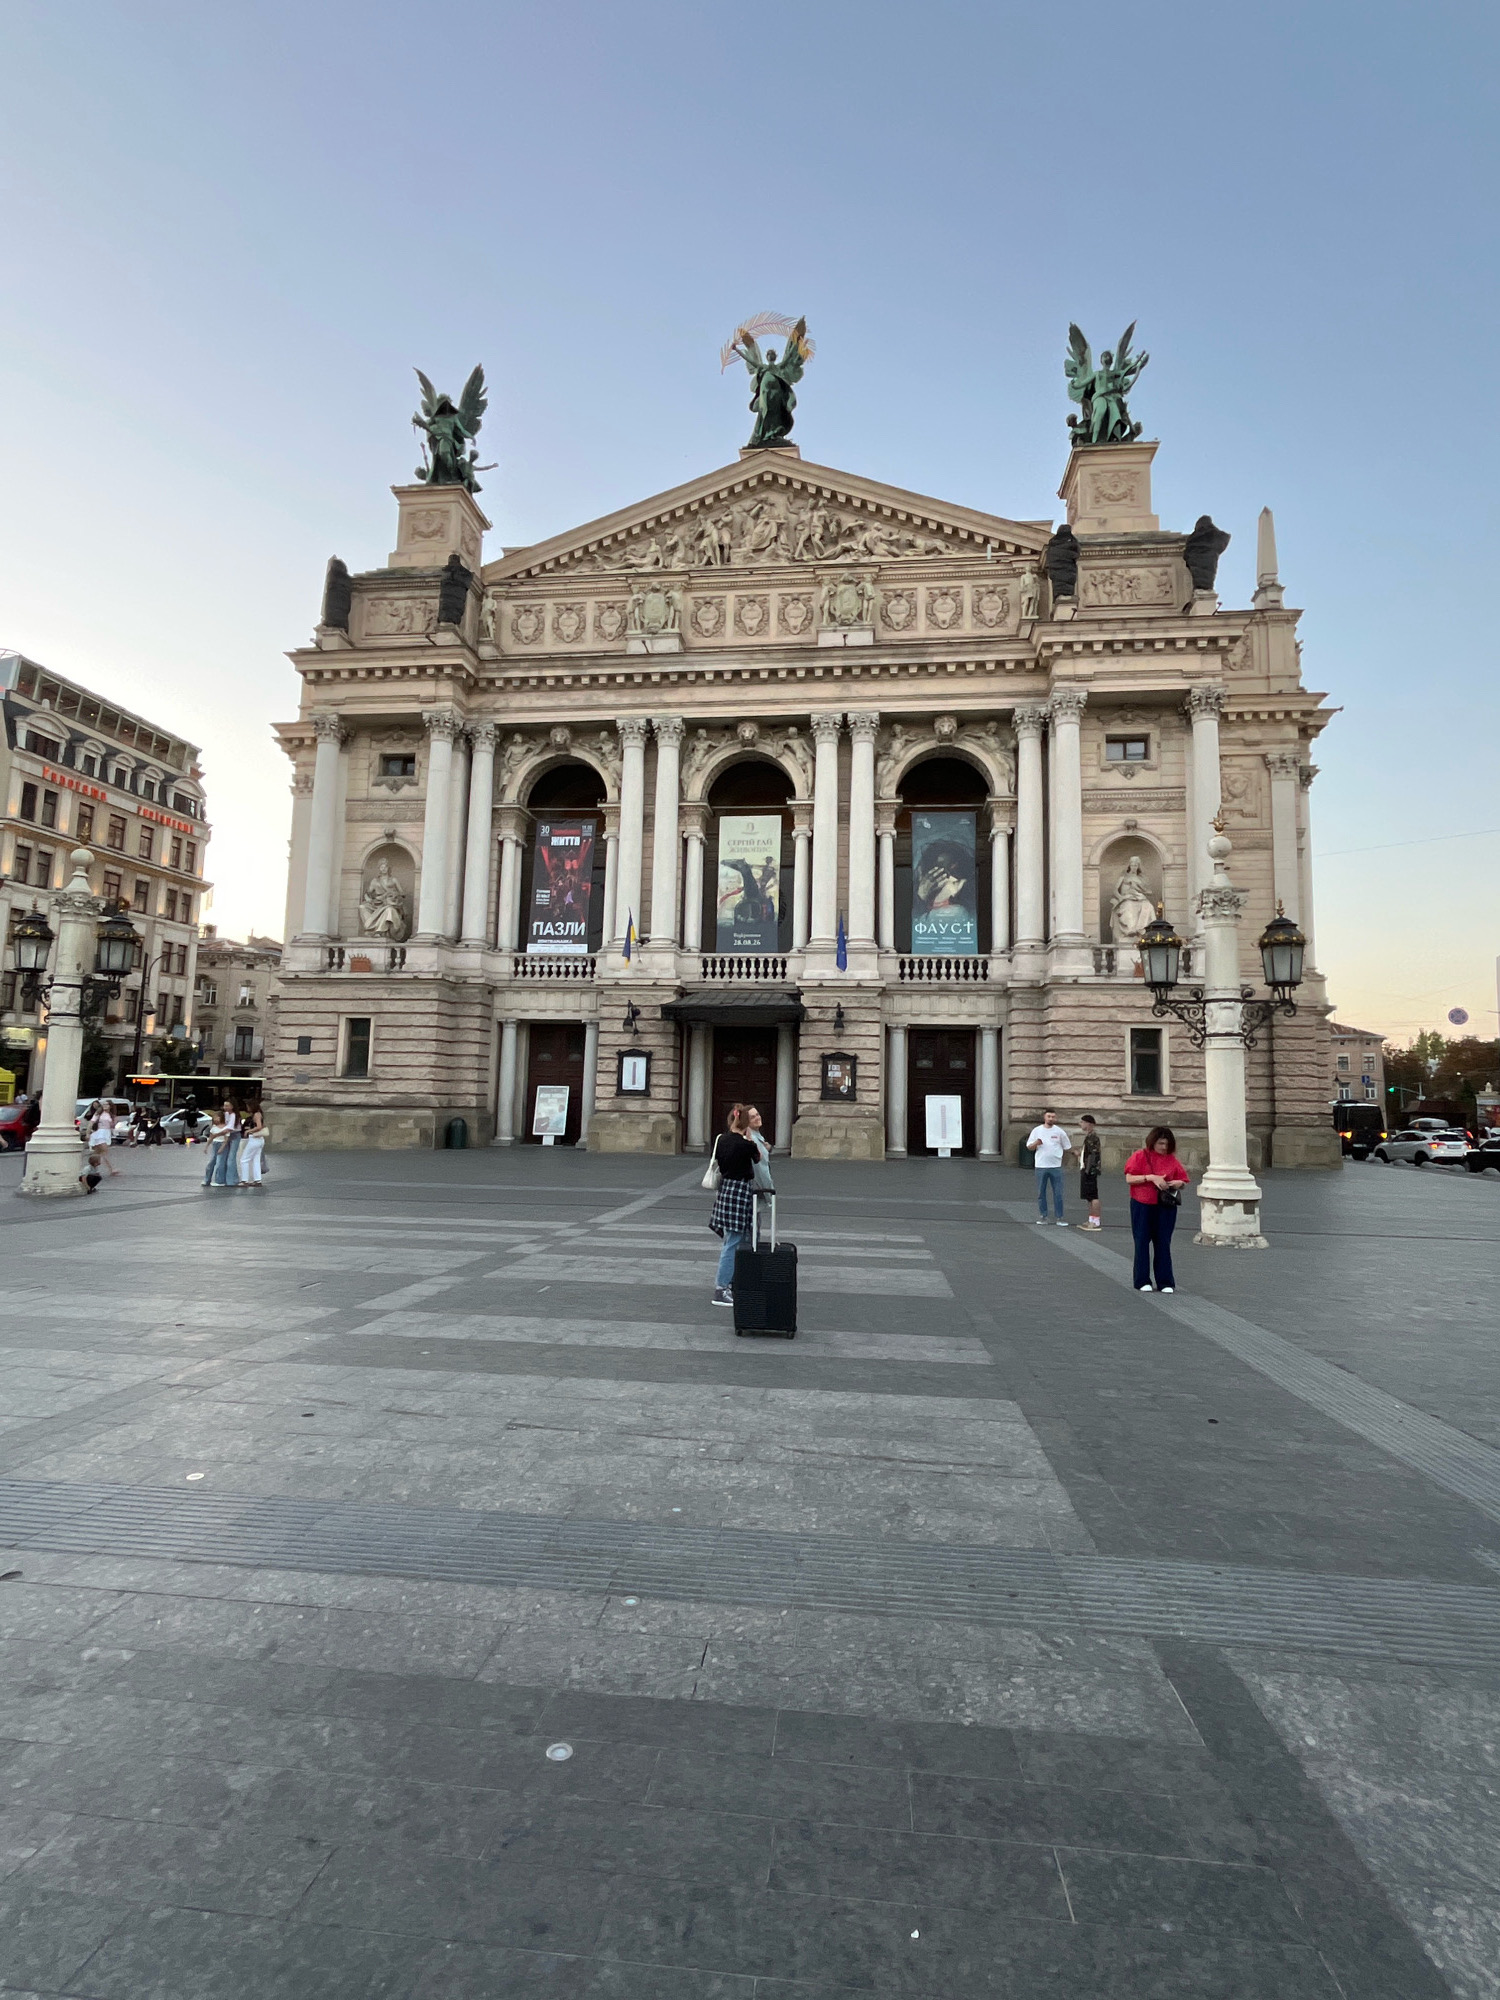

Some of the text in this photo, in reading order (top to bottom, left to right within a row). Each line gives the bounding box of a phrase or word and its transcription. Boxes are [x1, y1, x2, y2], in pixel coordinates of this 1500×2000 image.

[42, 766, 107, 803] Panorama
[540, 825, 550, 834] 30
[532, 921, 586, 936] ПАЗЛИ
[914, 921, 974, 934] ФАУСТ
